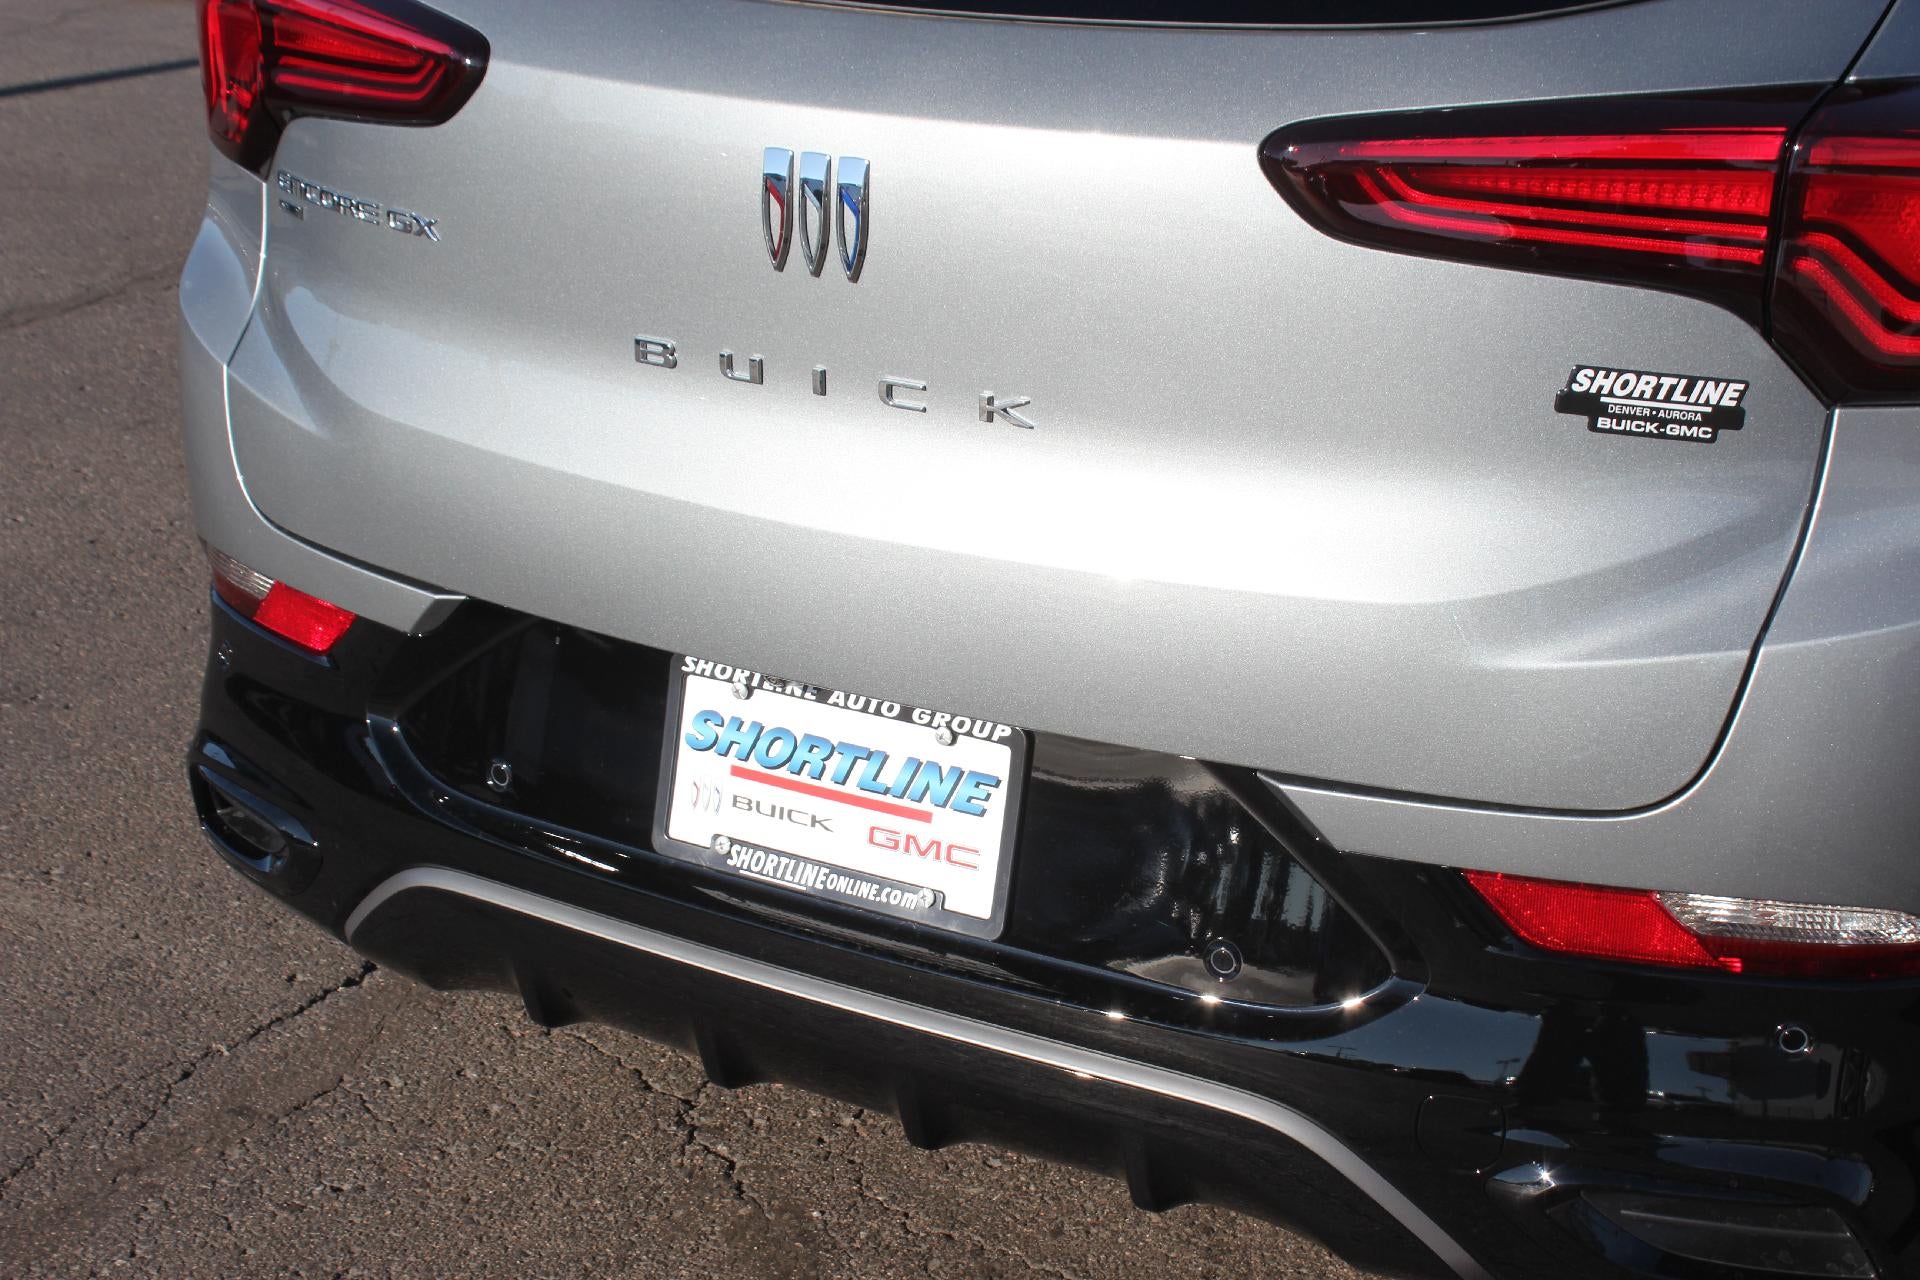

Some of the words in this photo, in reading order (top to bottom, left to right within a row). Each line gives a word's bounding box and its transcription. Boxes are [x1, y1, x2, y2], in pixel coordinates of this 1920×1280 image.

[386, 208, 441, 242] GX
[634, 334, 1035, 429] BUICK
[1571, 368, 1746, 407] SHORTLINE
[1596, 416, 1712, 439] BUICK-GMC
[1607, 404, 1650, 417] DENVER
[1658, 409, 1702, 422] AURORA
[681, 656, 818, 700] SHORTLNE
[827, 690, 901, 718] AUTO
[912, 708, 1013, 742] GROUP
[685, 710, 1001, 816] SHORTLINE
[731, 794, 834, 832] BUICK
[867, 825, 981, 871] GMC
